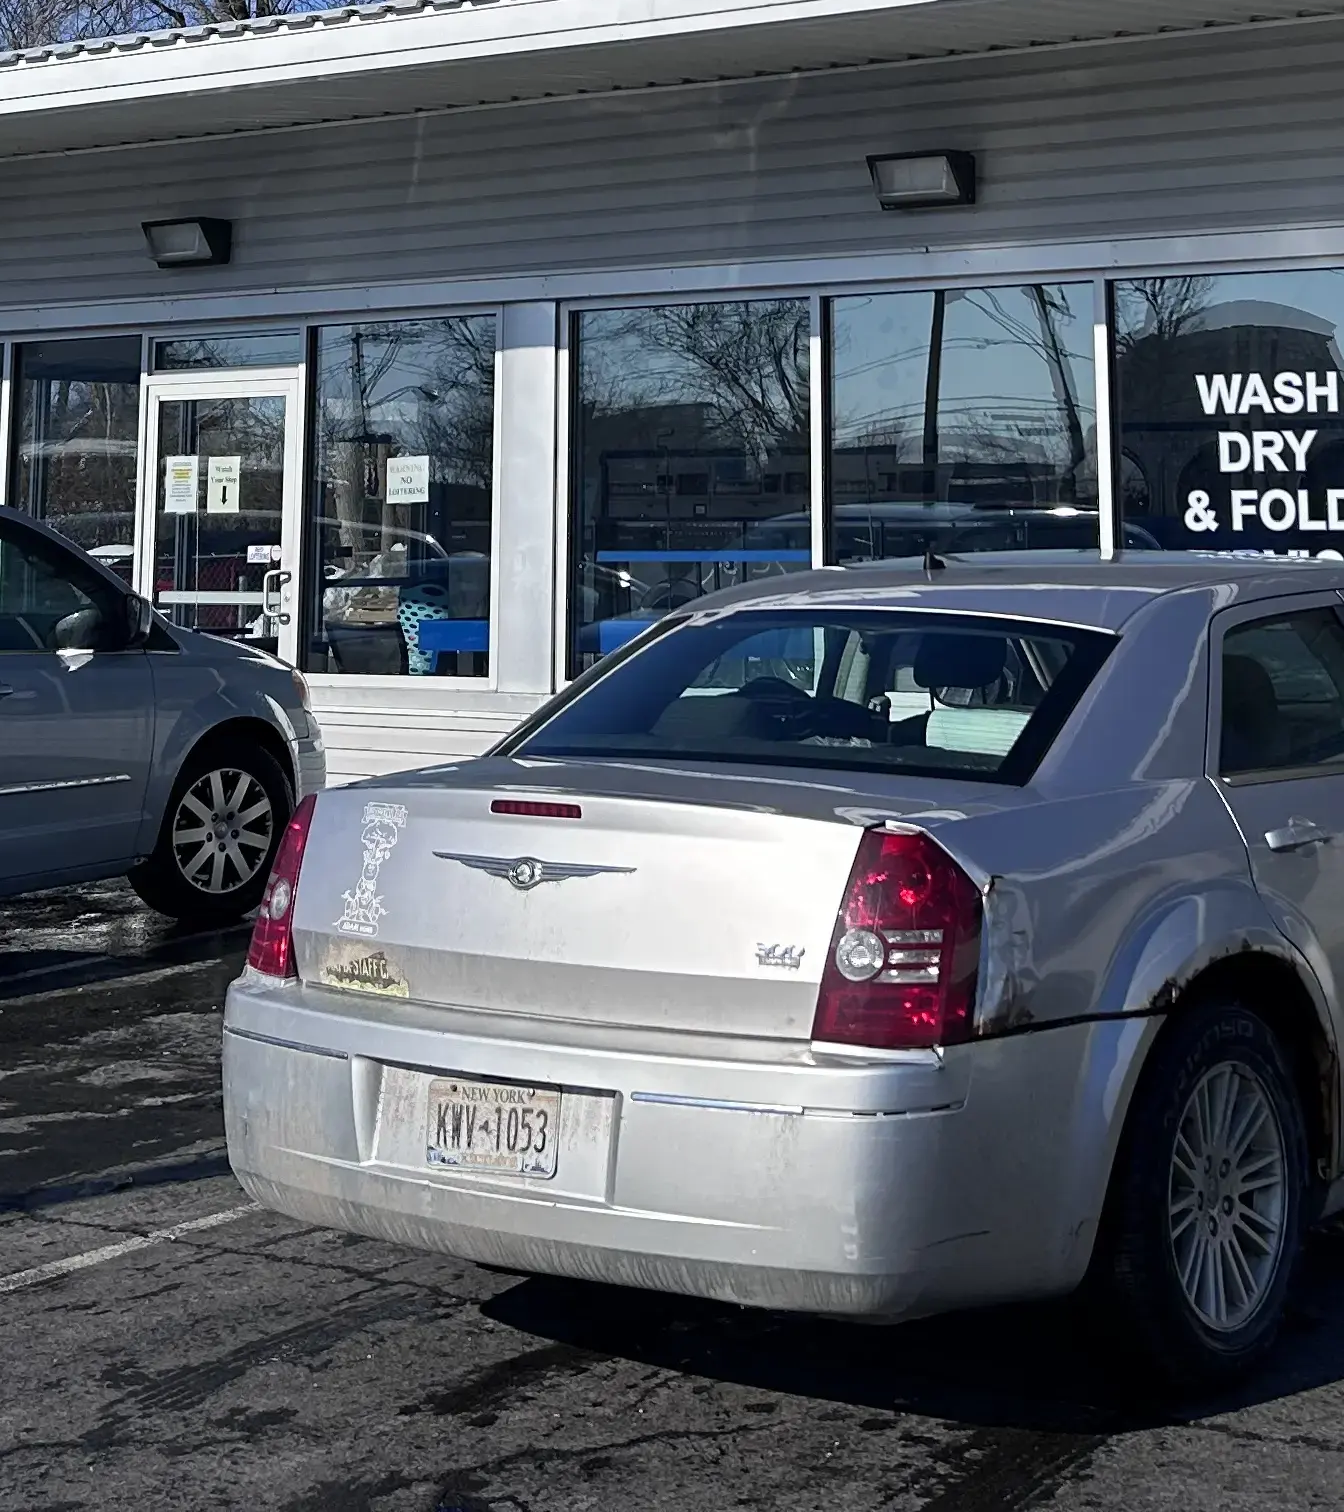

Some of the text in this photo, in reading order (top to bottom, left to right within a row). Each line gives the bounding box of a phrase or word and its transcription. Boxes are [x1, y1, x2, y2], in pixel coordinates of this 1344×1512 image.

[1195, 370, 1339, 415] WASH
[1217, 429, 1318, 473] DRY
[389, 486, 426, 496] LOITERING
[400, 476, 413, 485] NO
[1183, 490, 1220, 533] &
[461, 1086, 526, 1104] NEW YORK
